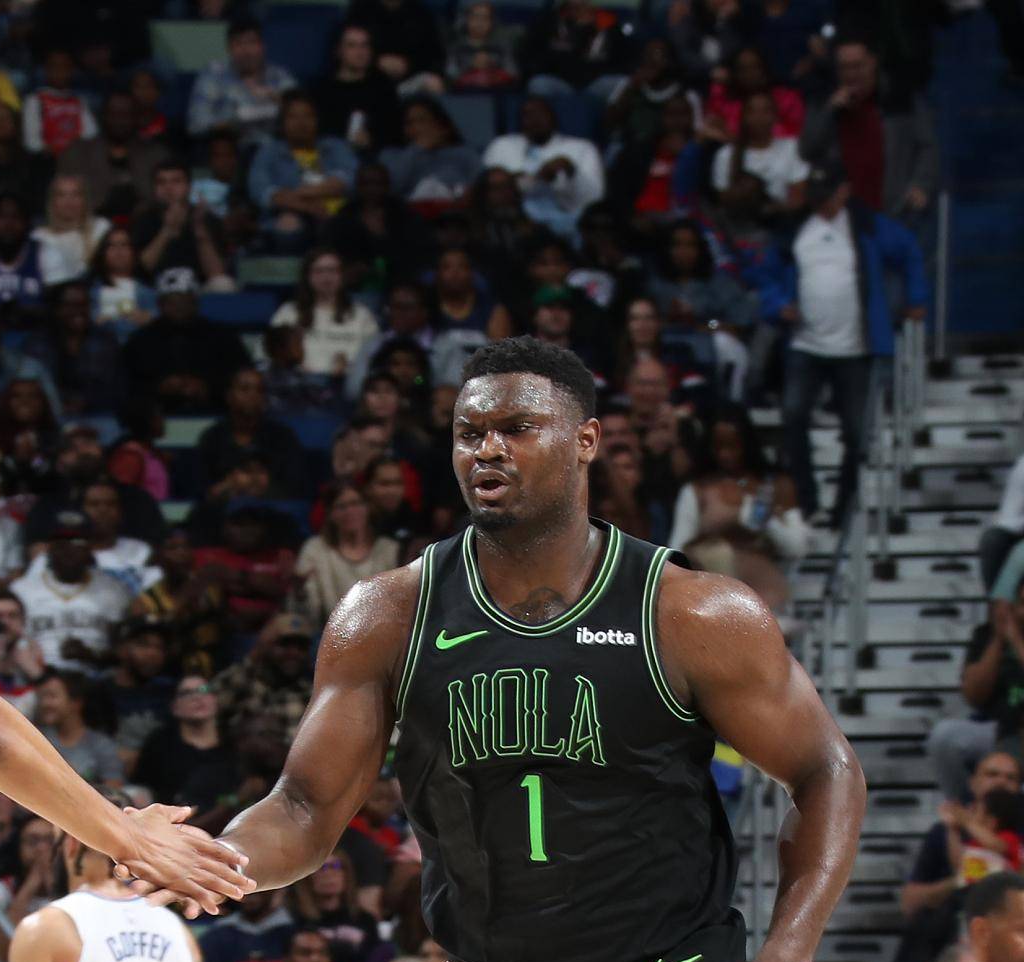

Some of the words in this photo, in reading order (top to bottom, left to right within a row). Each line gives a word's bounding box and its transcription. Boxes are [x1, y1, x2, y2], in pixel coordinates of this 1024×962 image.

[576, 627, 637, 646] ibotta
[448, 668, 607, 767] NOLA
[520, 775, 549, 861] 1
[106, 931, 171, 962] COFFEY
